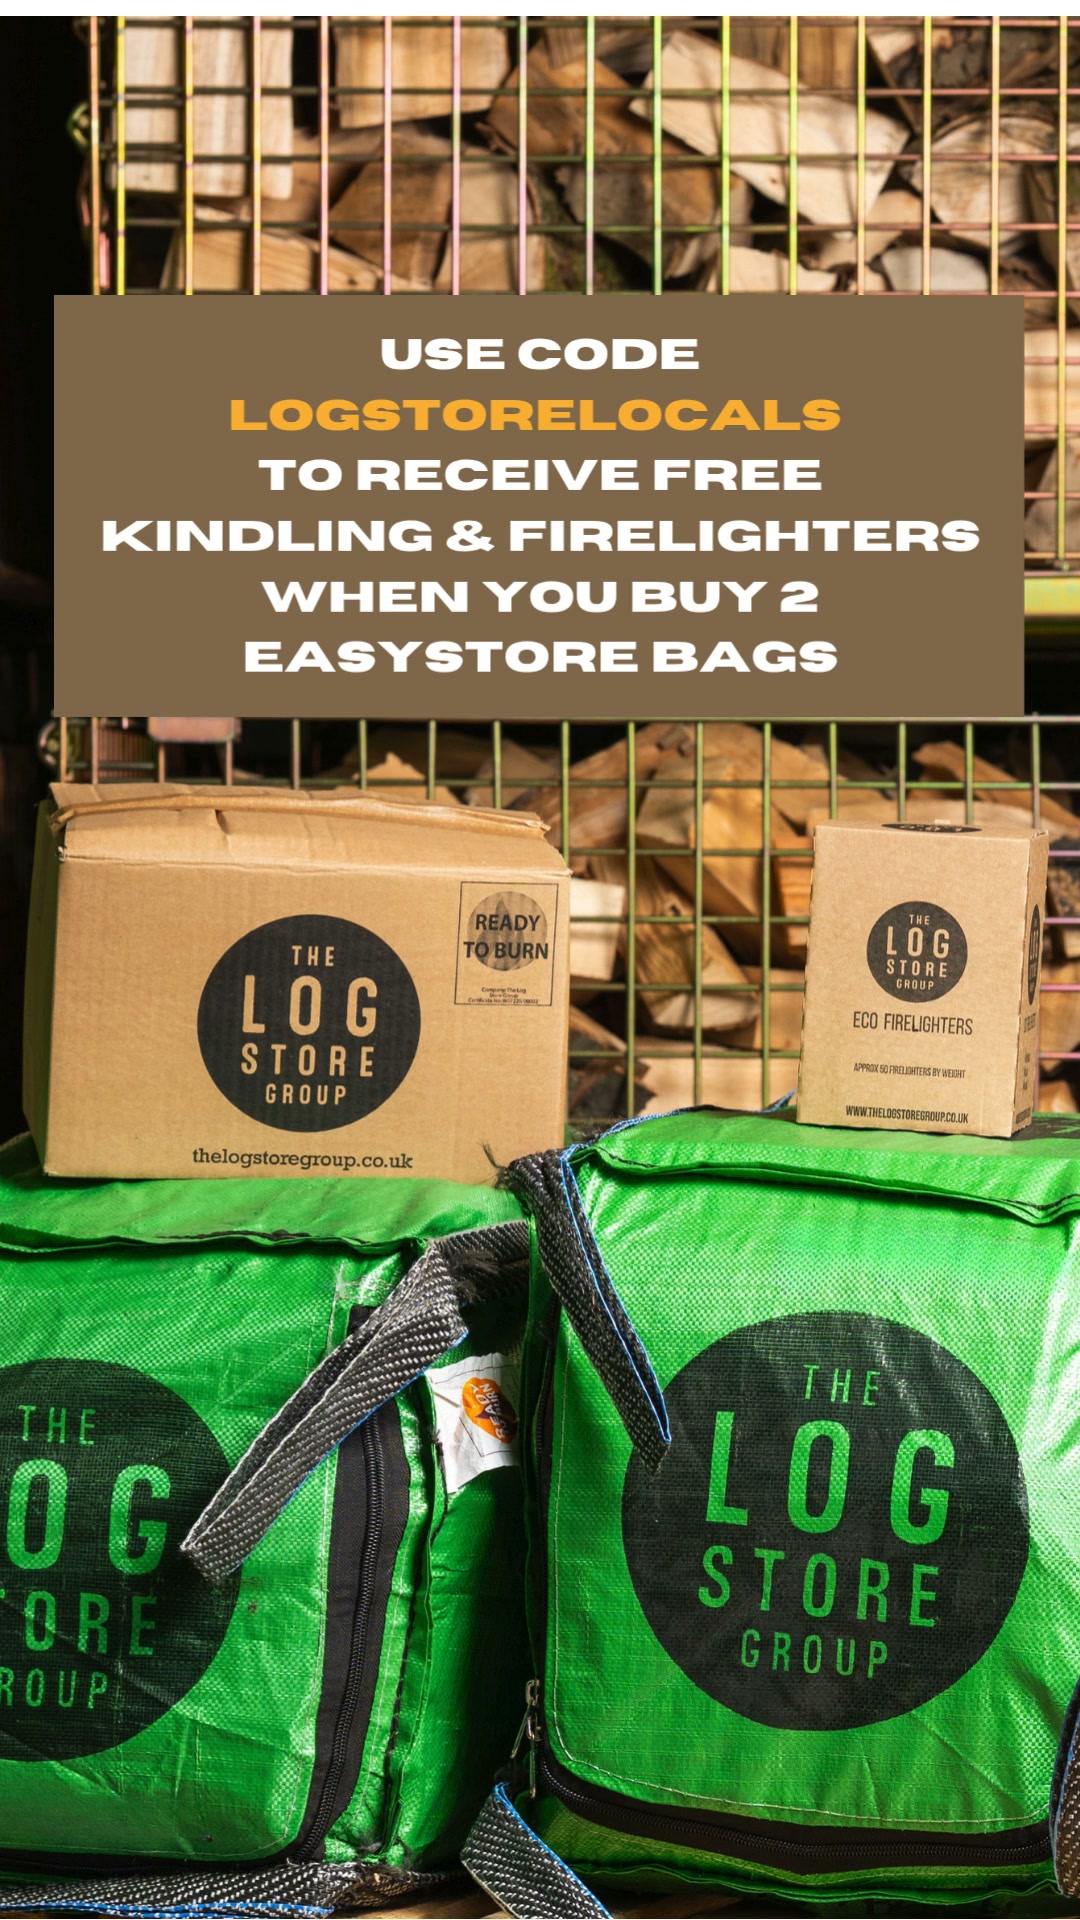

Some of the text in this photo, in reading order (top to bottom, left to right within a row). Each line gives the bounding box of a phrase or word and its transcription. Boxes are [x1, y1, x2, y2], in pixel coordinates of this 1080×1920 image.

[475, 913, 541, 932] READY
[908, 914, 930, 926] THE
[463, 941, 549, 960] TO BURN
[886, 925, 950, 959] LOG
[291, 945, 335, 967] THE
[886, 958, 948, 978] STORE
[896, 978, 935, 991] GROUP
[242, 974, 378, 1037] LOG
[853, 1011, 974, 1036] ECO FIRELIGHTERS
[241, 1042, 374, 1078] STORE
[853, 1062, 966, 1079] APPROX 50 FIRELIGHTERS BY WEIGHT
[265, 1083, 347, 1105] GROUP
[845, 1104, 969, 1124] WWW.THELOGSTOREGROUP.CO.UK
[192, 1147, 413, 1171] thelogstoregroup.co.uk
[803, 1363, 881, 1407] THE
[18, 1404, 97, 1446] THE
[705, 1410, 956, 1546] LOG
[698, 1544, 940, 1628] STORE
[0, 1588, 158, 1656] ORE
[740, 1627, 888, 1679] GROUP
